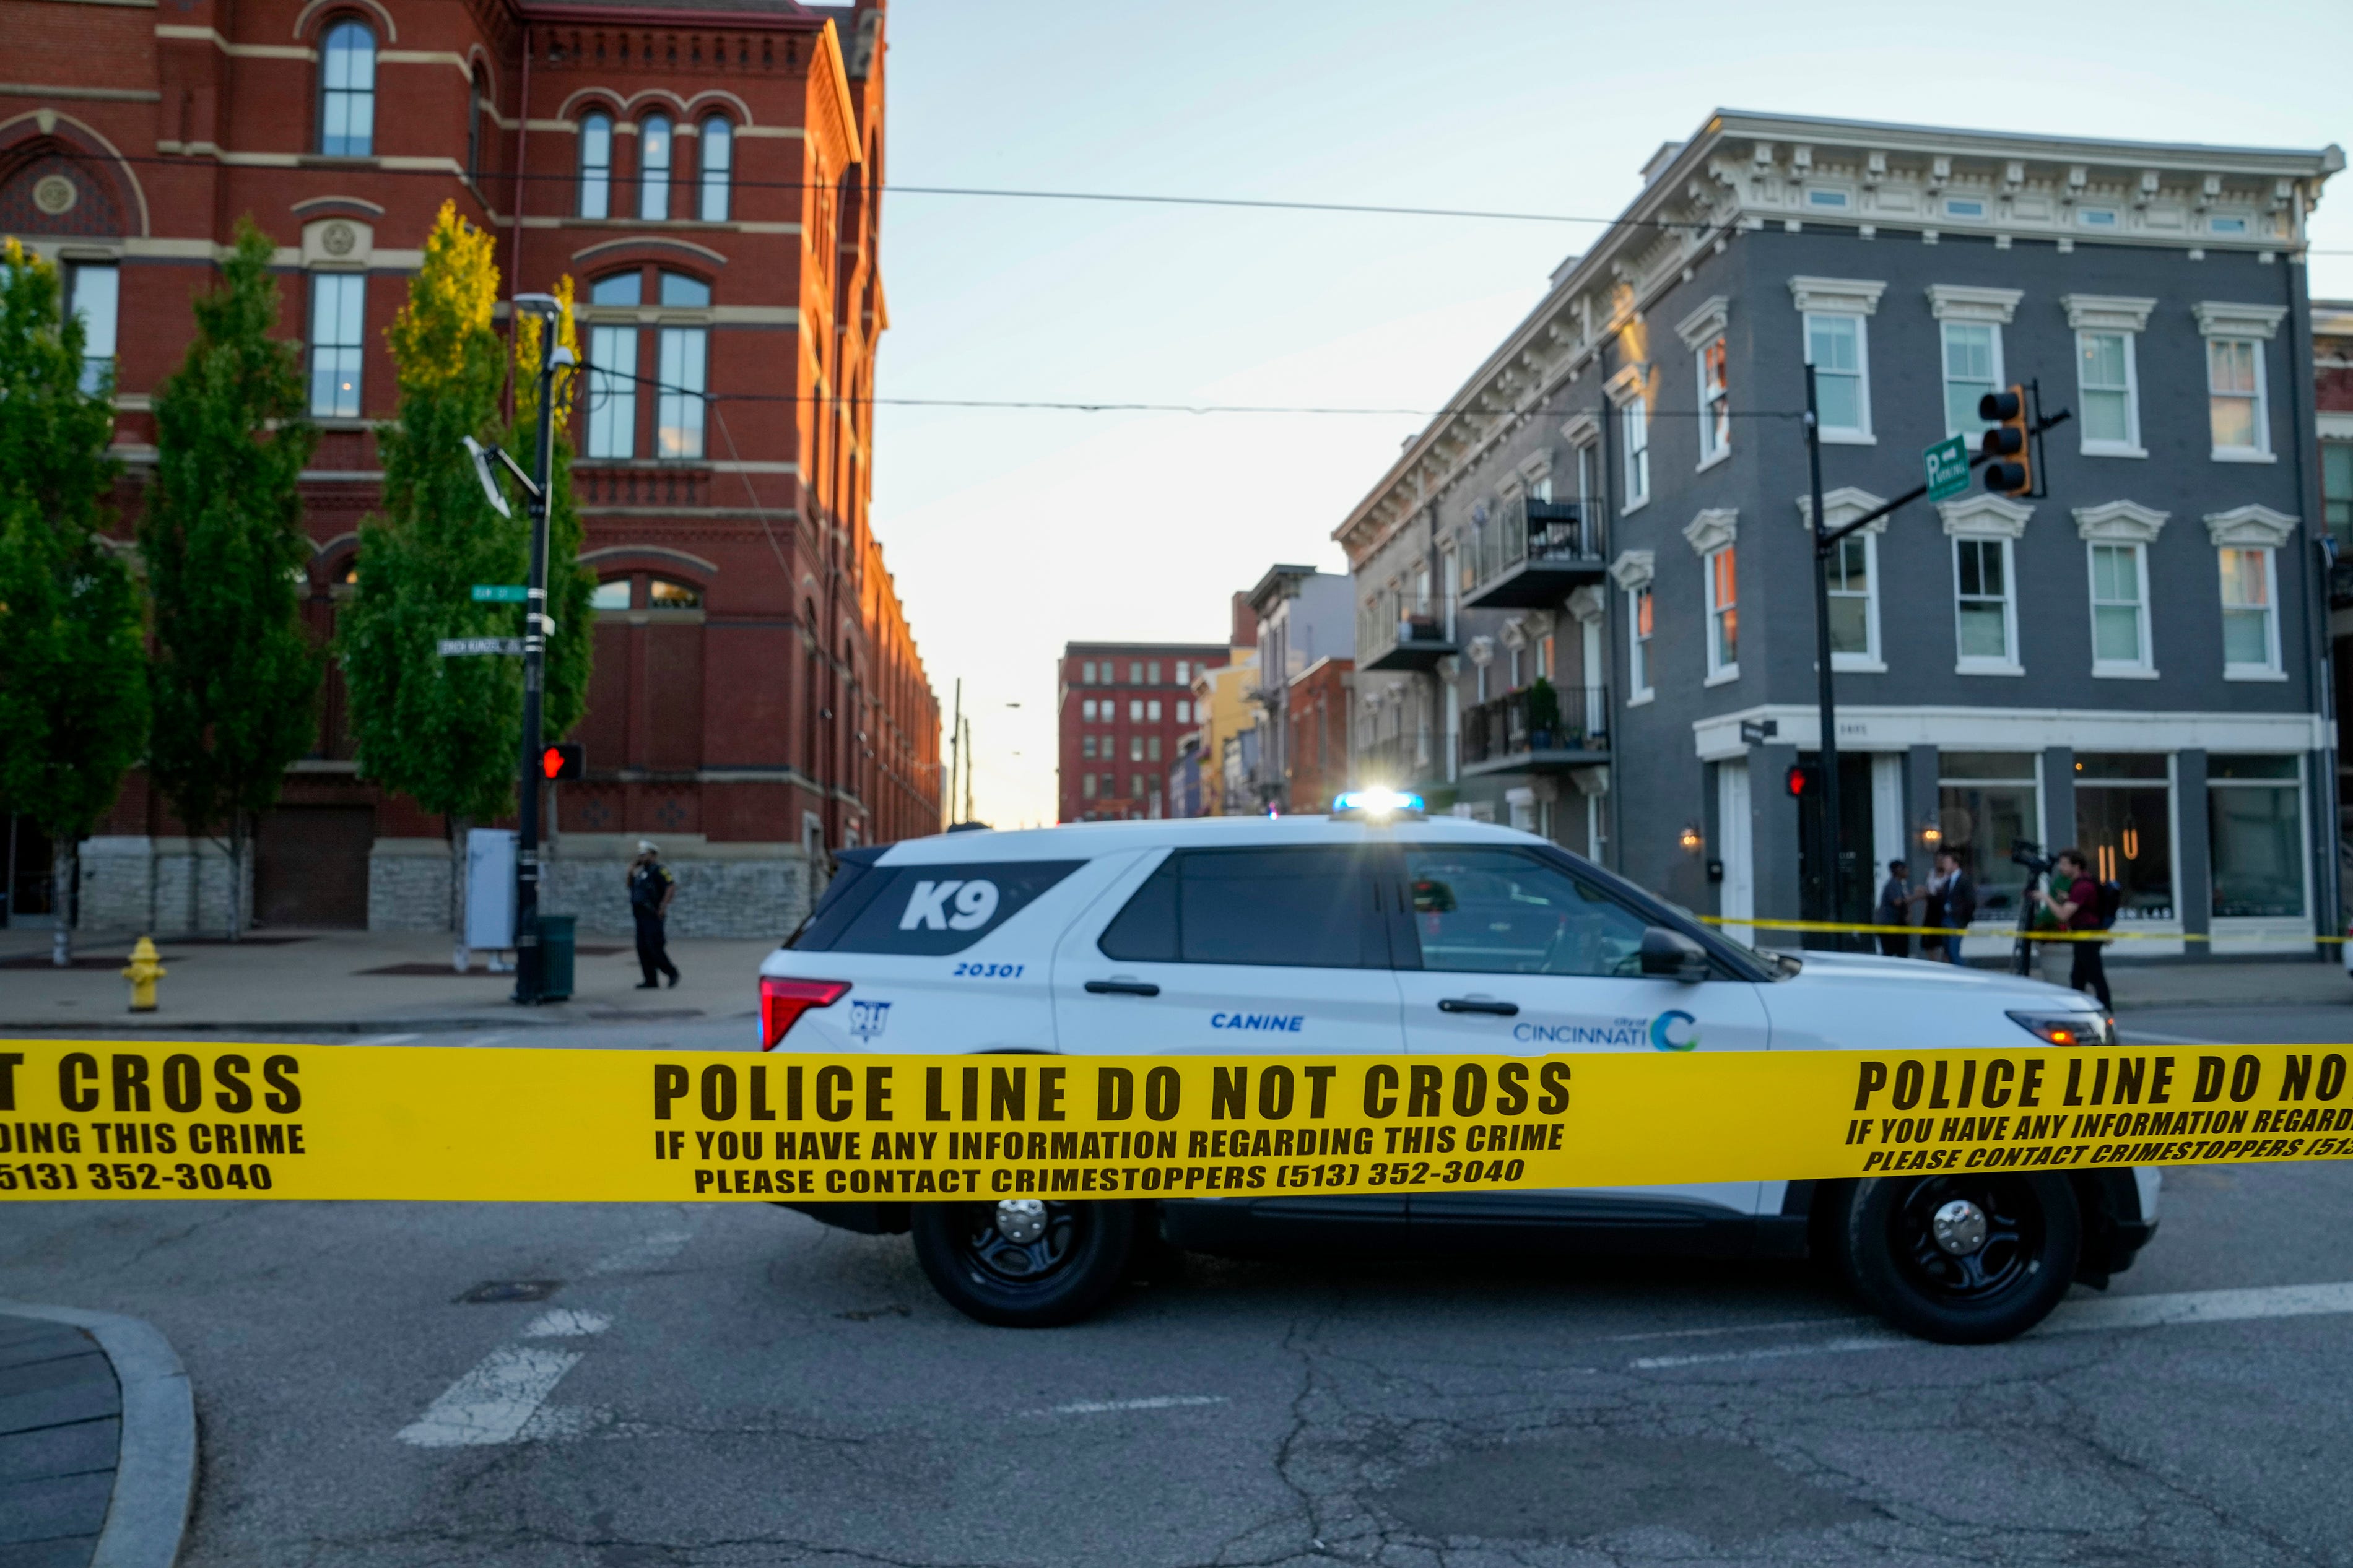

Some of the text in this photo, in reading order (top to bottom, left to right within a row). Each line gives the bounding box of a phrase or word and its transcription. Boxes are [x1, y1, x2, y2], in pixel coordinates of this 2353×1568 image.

[899, 879, 999, 931] K9
[954, 963, 1025, 978] 20301
[1211, 1013, 1305, 1032] CANINE
[1513, 1022, 1647, 1046] CINCINNATI
[1614, 1017, 1648, 1028] city of
[0, 1052, 302, 1114] T CROSS
[654, 1062, 1571, 1122] POLICE LINE DO NOT CROSS
[1853, 1053, 2353, 1111] POLICE LINE DO NO
[91, 1122, 177, 1154] THIS
[188, 1123, 305, 1154] CRIME
[655, 1123, 1565, 1161] IF YOU HAVE ANY INFORMATION REGARDING THIS CRIME
[1845, 1108, 2353, 1145] IF YOU HAVE ANY INFORMATION REGARD
[1862, 1149, 1963, 1172] PLEASE
[1964, 1145, 2091, 1168] CONTACT
[2089, 1138, 2305, 1164] CRIMESTOPPERS
[87, 1163, 272, 1190] 352-3040
[695, 1169, 814, 1194] PLEASE
[825, 1169, 981, 1193] CONTACT
[991, 1165, 1266, 1193] CRIMESTOPPERS
[1368, 1159, 1525, 1185] 352-3040
